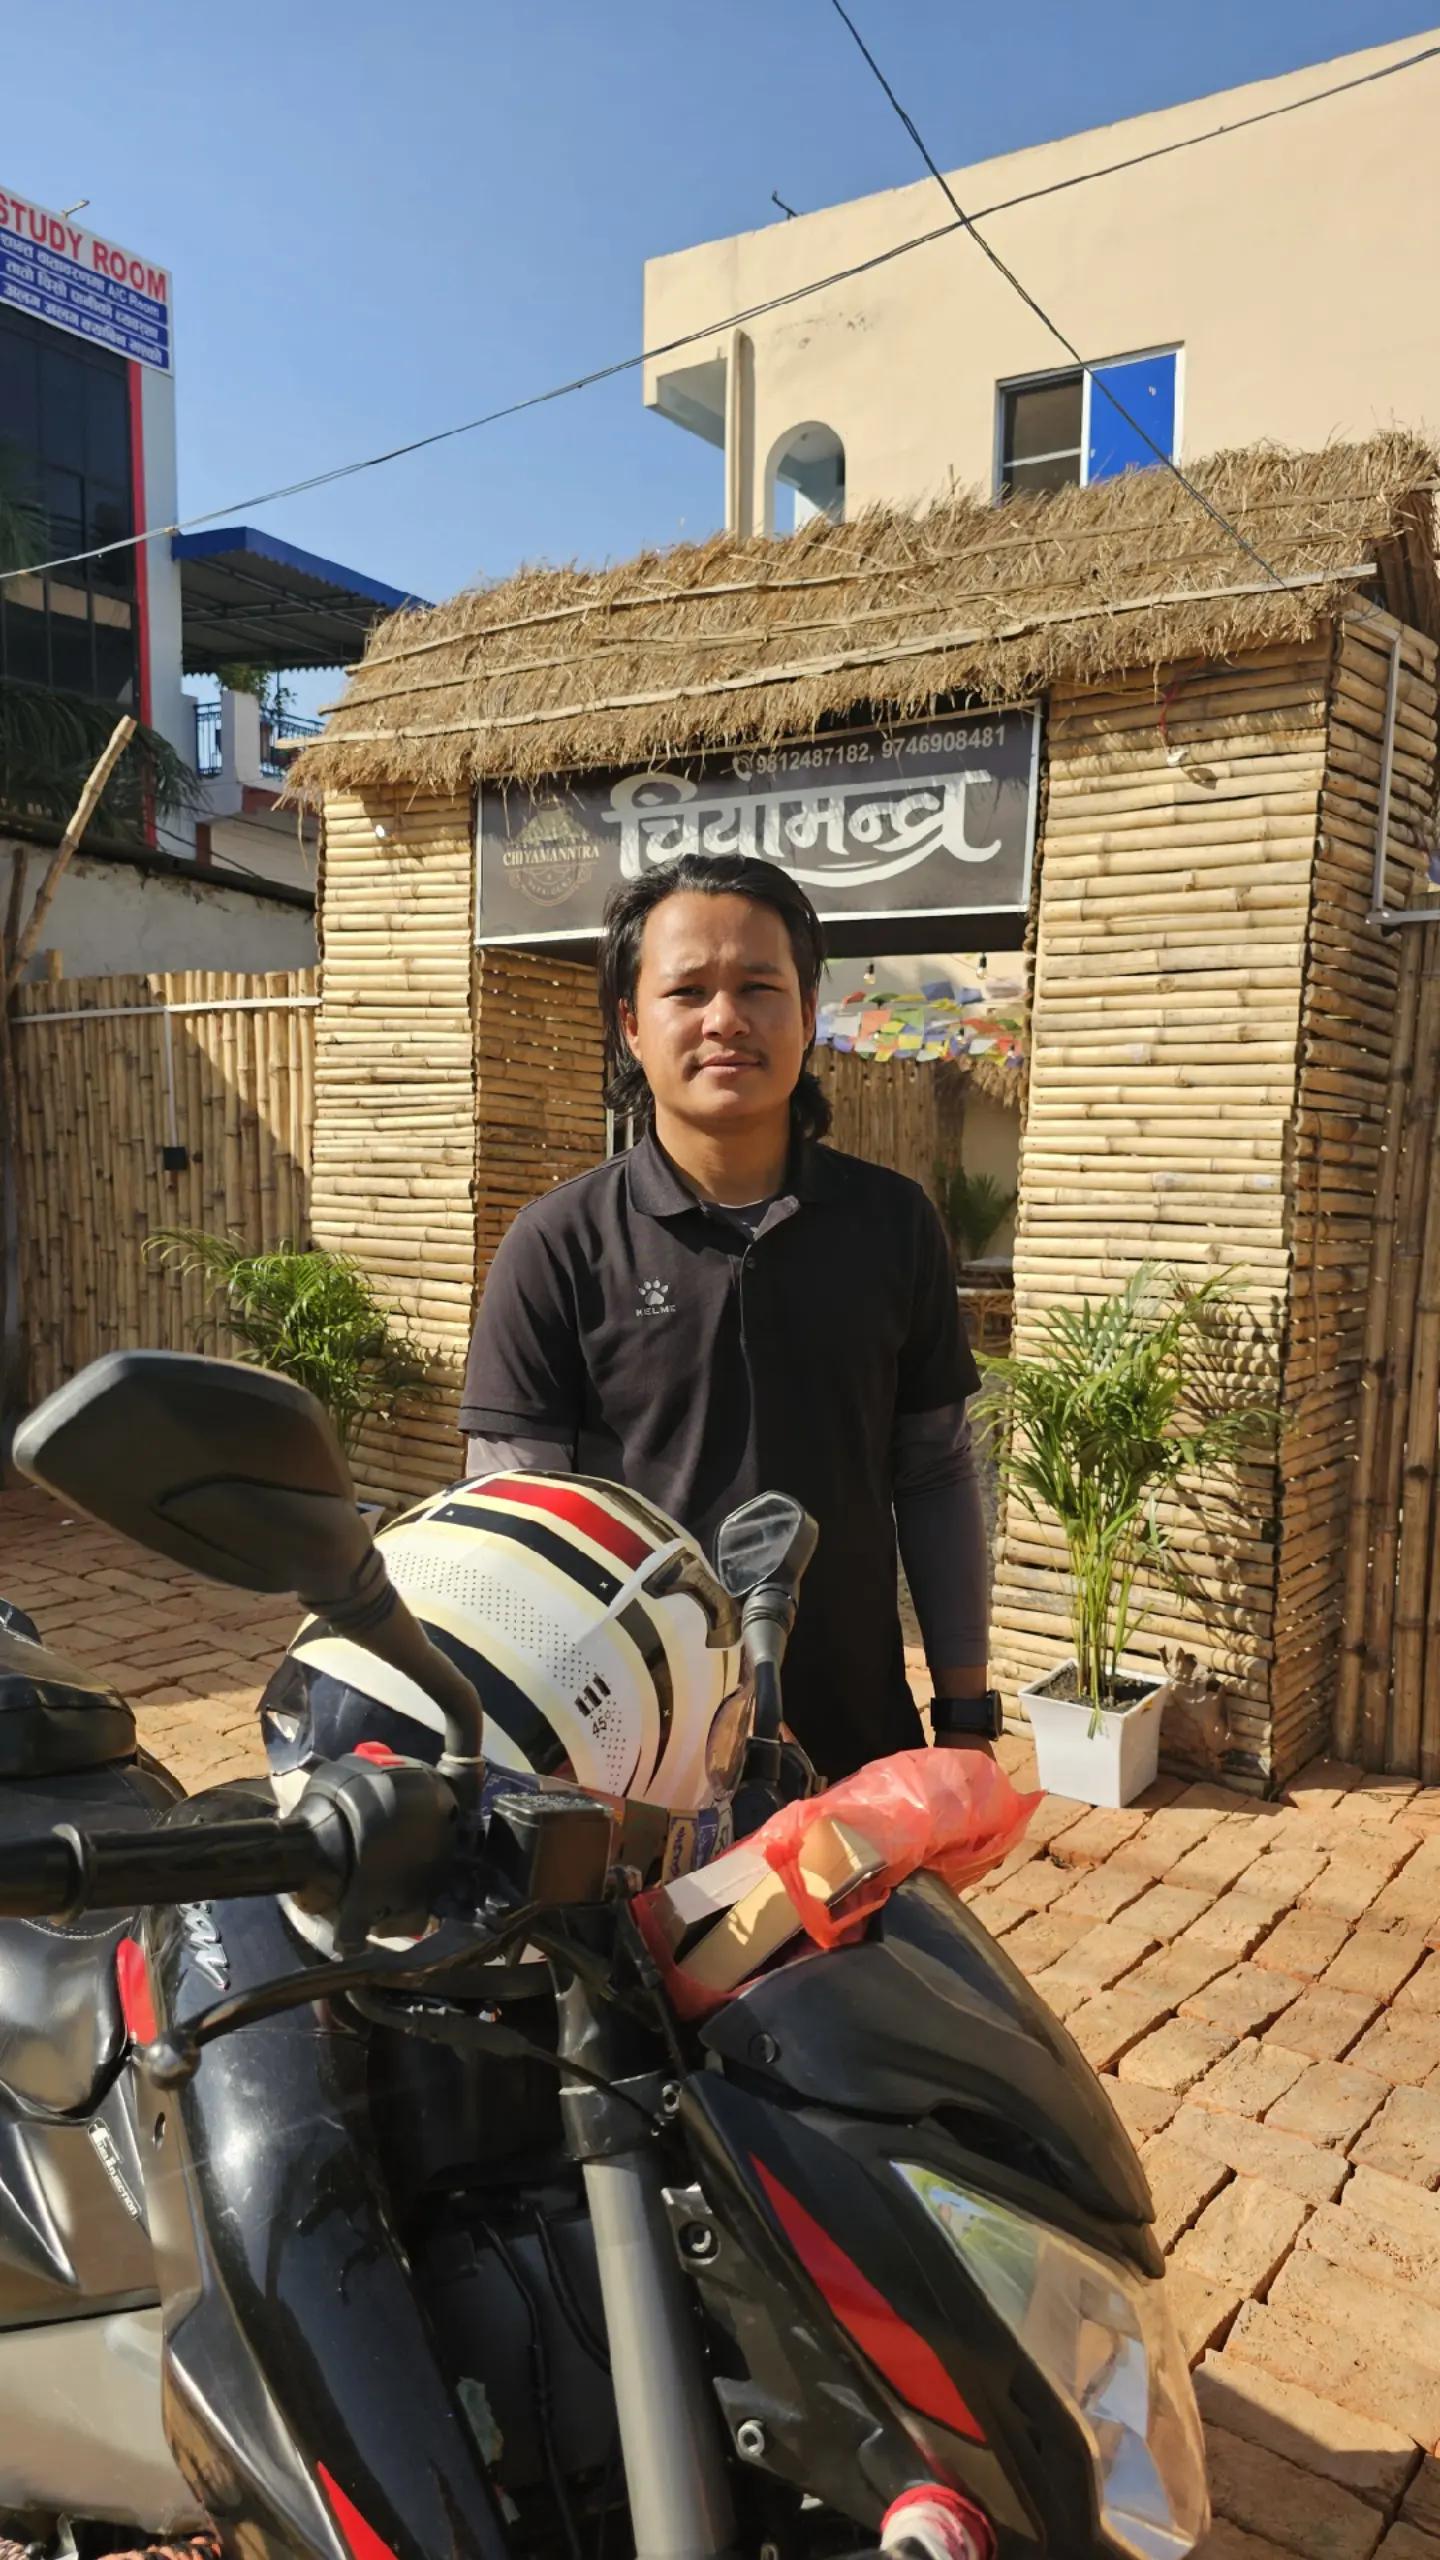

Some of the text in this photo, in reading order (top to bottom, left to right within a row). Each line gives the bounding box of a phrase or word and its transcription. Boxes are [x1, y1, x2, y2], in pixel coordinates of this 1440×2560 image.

[0, 192, 166, 304] STUDY ROOM
[882, 725, 1006, 758] 9746908481
